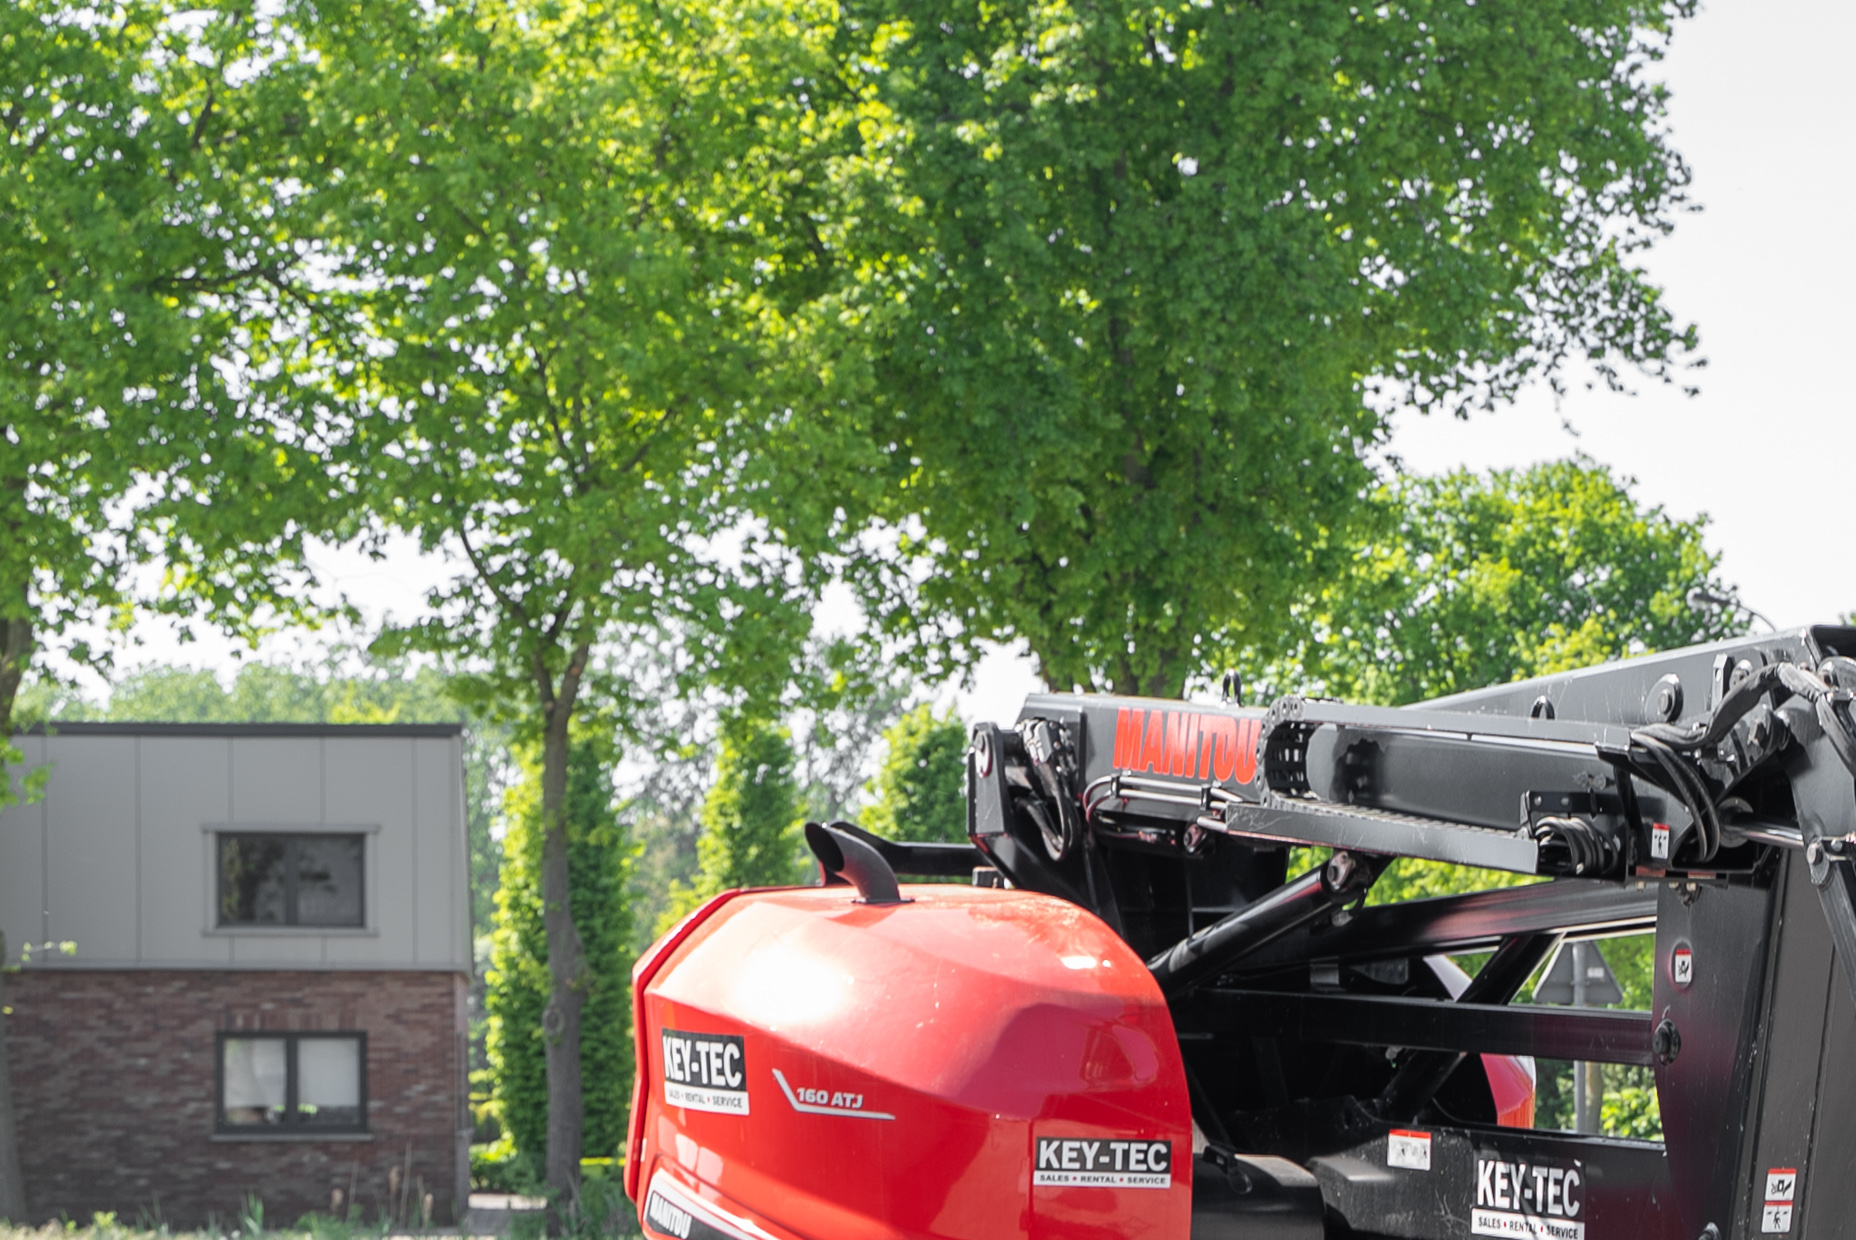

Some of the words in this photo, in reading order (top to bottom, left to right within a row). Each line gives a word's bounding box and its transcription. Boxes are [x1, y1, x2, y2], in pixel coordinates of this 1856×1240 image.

[1113, 707, 1261, 784] MANITOU
[663, 1036, 742, 1087] KEY-TEC
[712, 1095, 742, 1108] SERVICE
[797, 1087, 828, 1104] 160
[831, 1091, 863, 1109] ATJ
[1039, 1140, 1168, 1171] KEY-TEC
[1040, 1174, 1069, 1182] SALES
[1477, 1160, 1580, 1217] KEY-TEC
[1479, 1216, 1501, 1229] SALES
[1509, 1221, 1537, 1235] RENTAL
[1547, 1225, 1578, 1239] SERVICE
